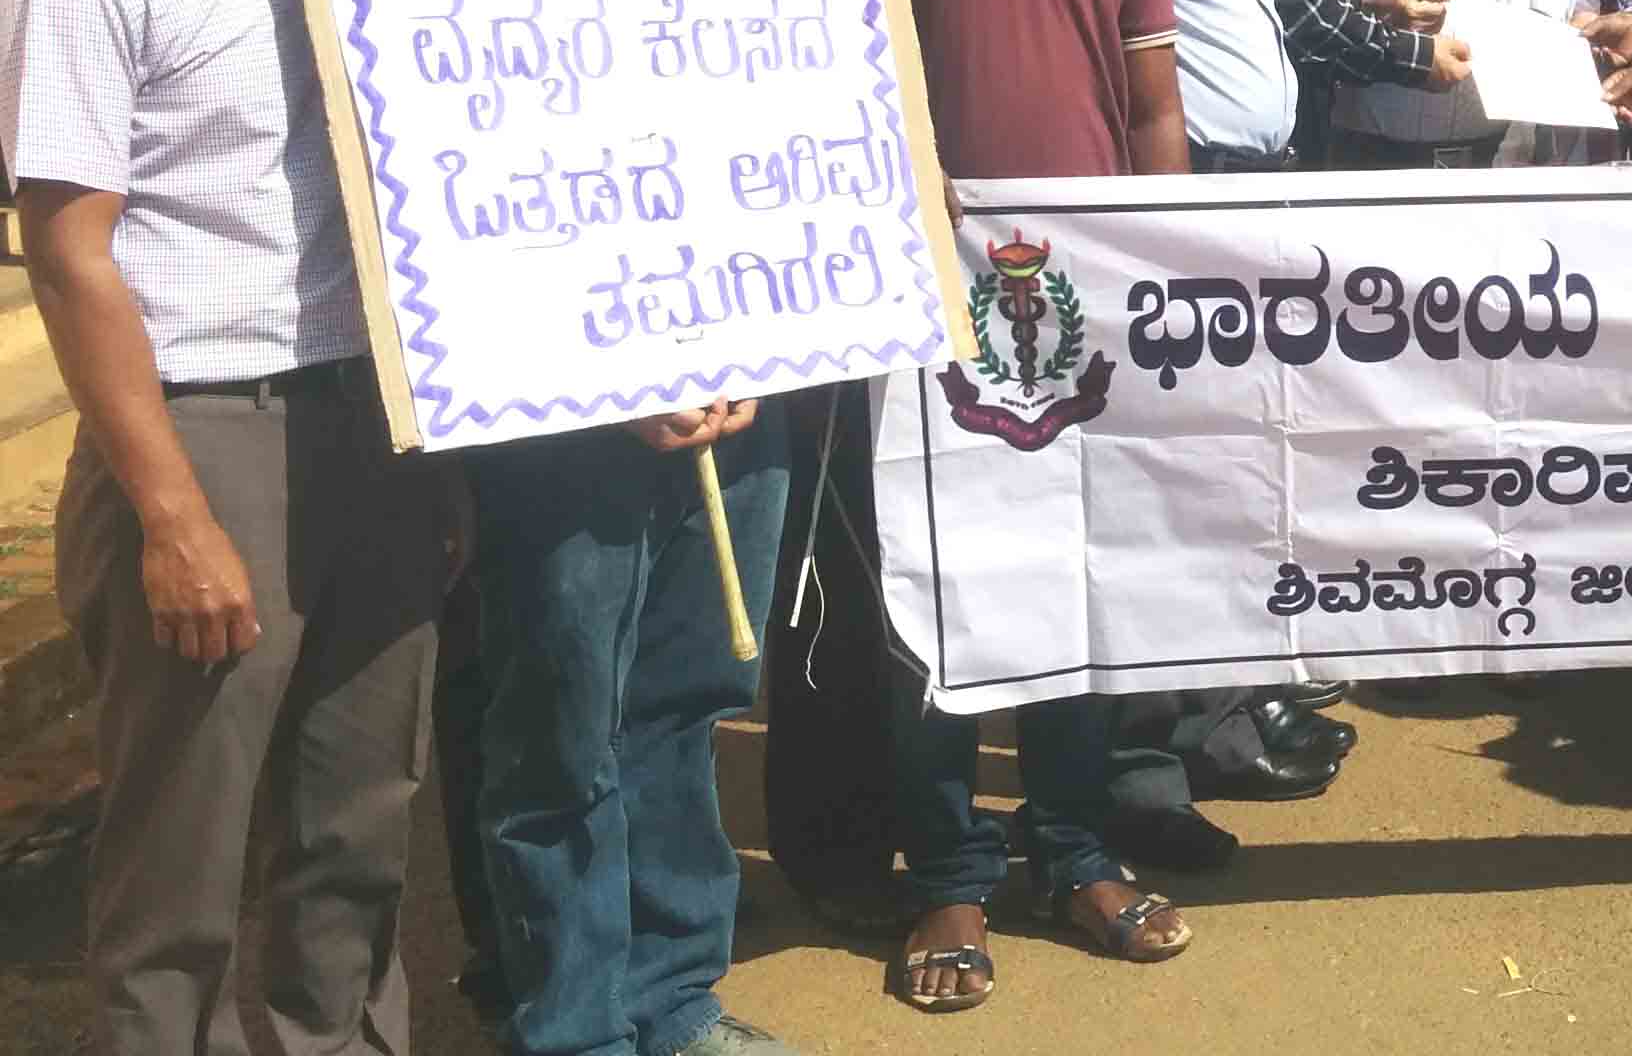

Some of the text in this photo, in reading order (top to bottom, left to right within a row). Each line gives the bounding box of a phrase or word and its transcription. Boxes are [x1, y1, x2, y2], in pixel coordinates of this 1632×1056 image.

[433, 99, 895, 251] ಒತ್ತಡದ ಅರಿವು
[1127, 238, 1599, 390] ಭಾರತೀಯ
[1266, 553, 1537, 637] ಶಿವಮೊಗ್ಗ
